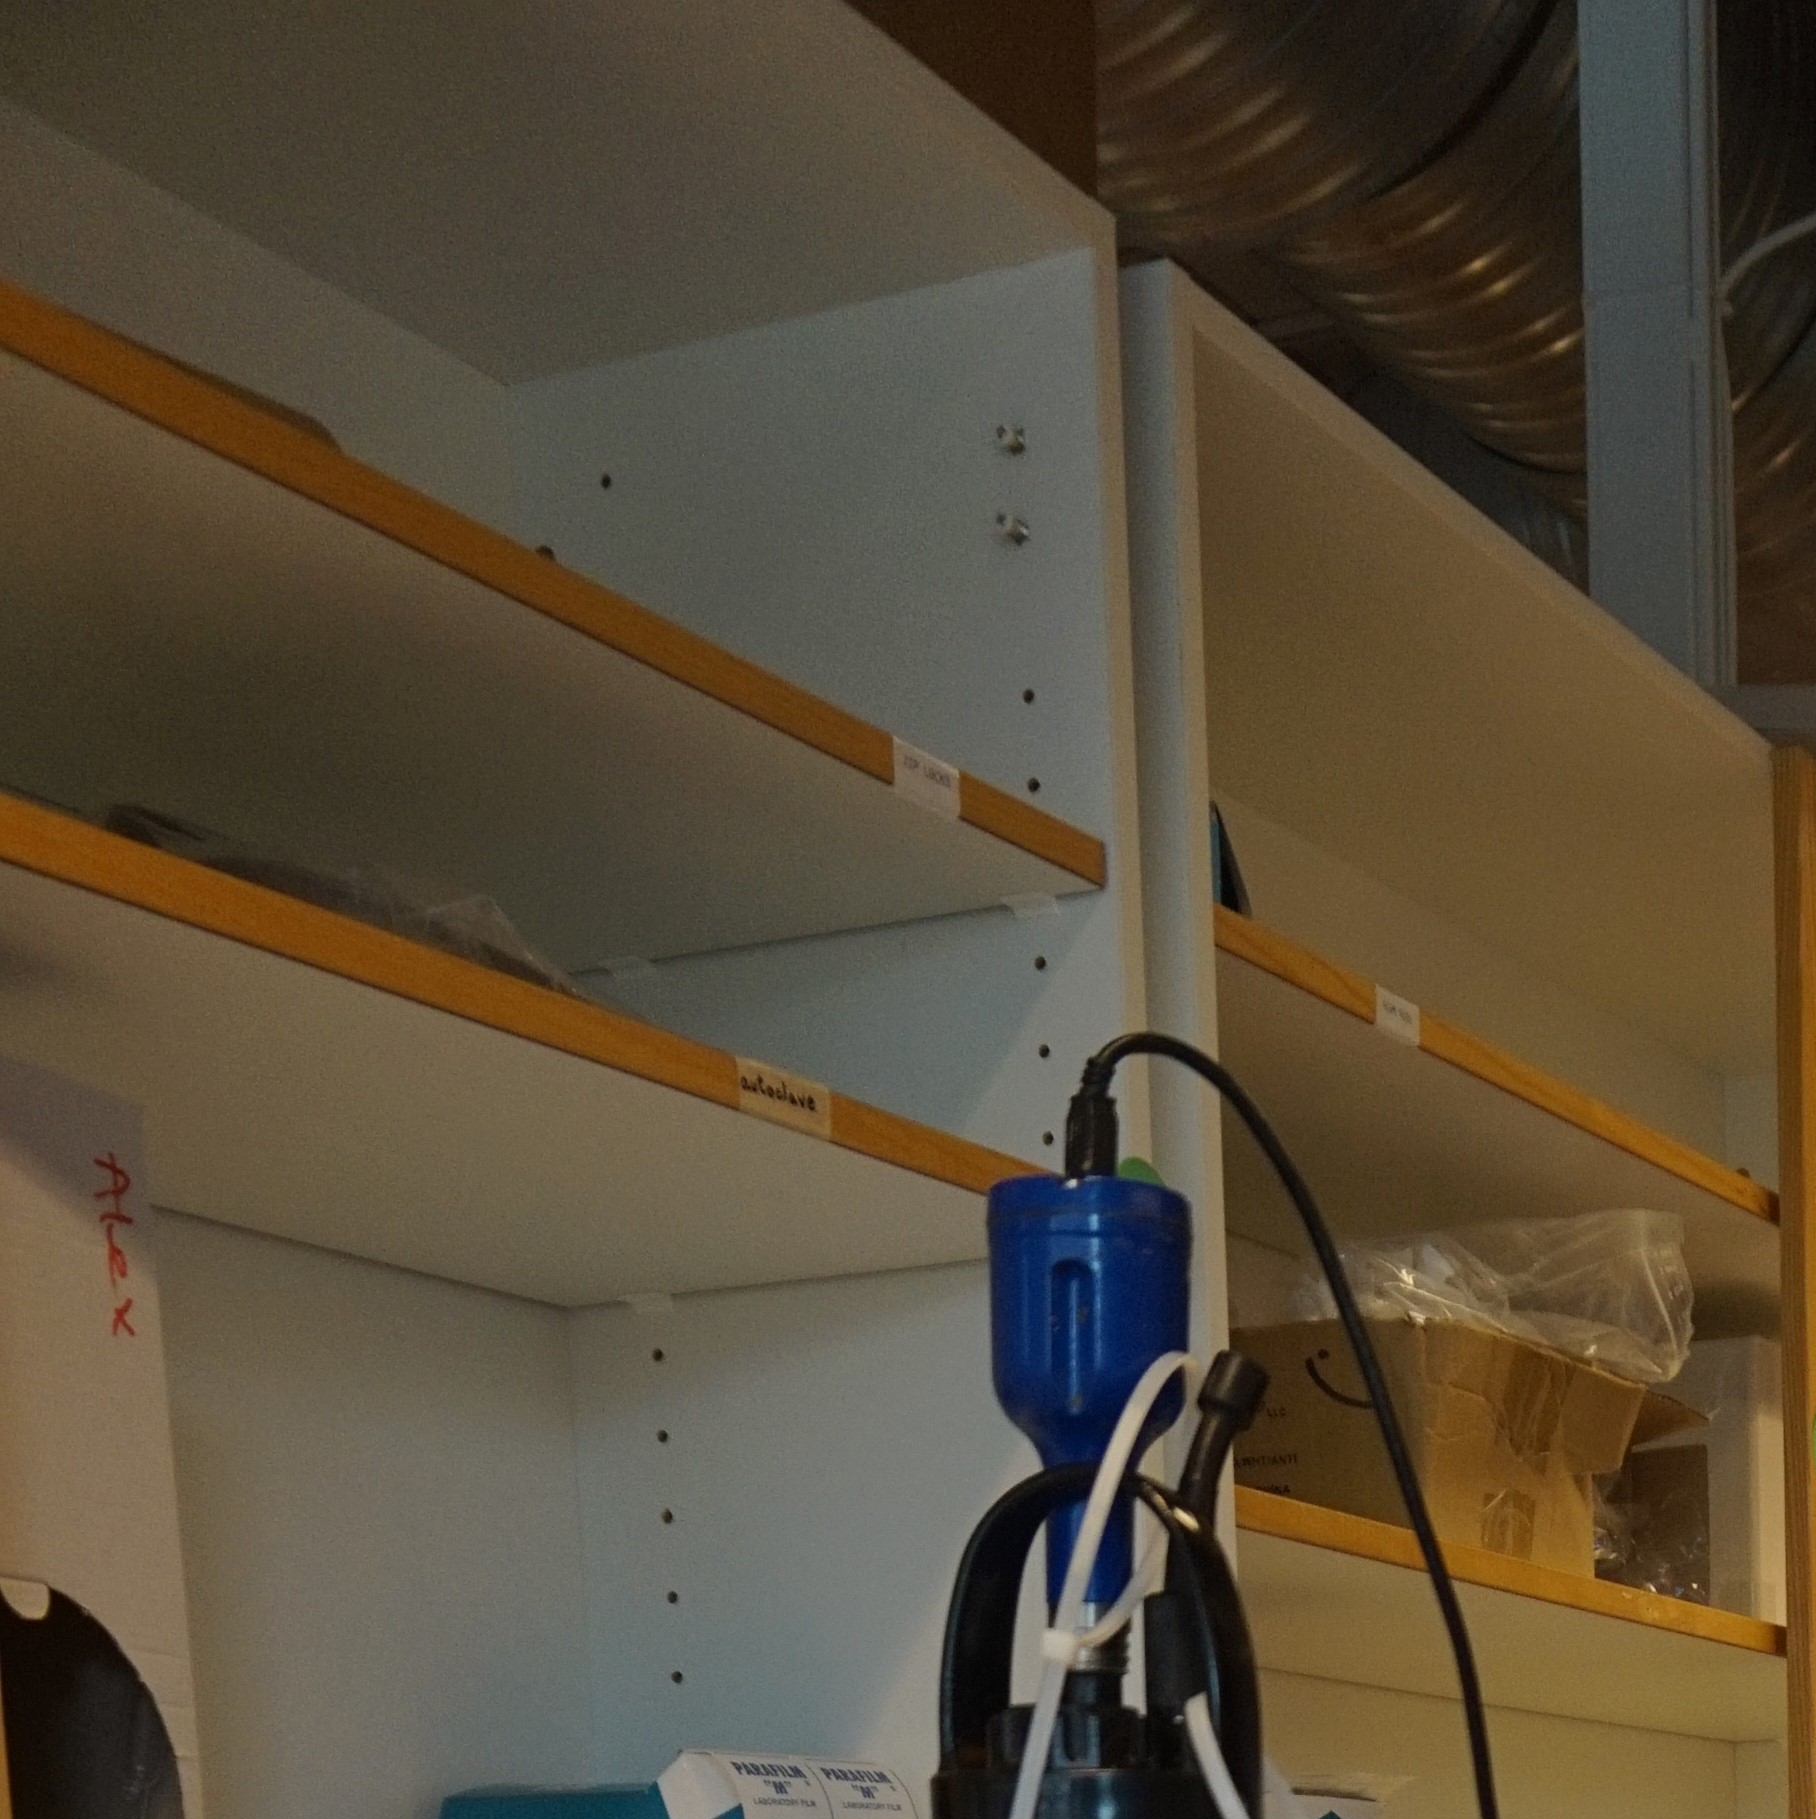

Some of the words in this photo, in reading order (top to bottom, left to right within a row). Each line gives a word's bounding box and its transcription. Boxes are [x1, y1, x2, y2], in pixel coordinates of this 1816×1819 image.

[740, 1074, 817, 1111] autoclave
[730, 1761, 807, 1780] PARAFILM
[820, 1766, 892, 1784] PARAFILM
